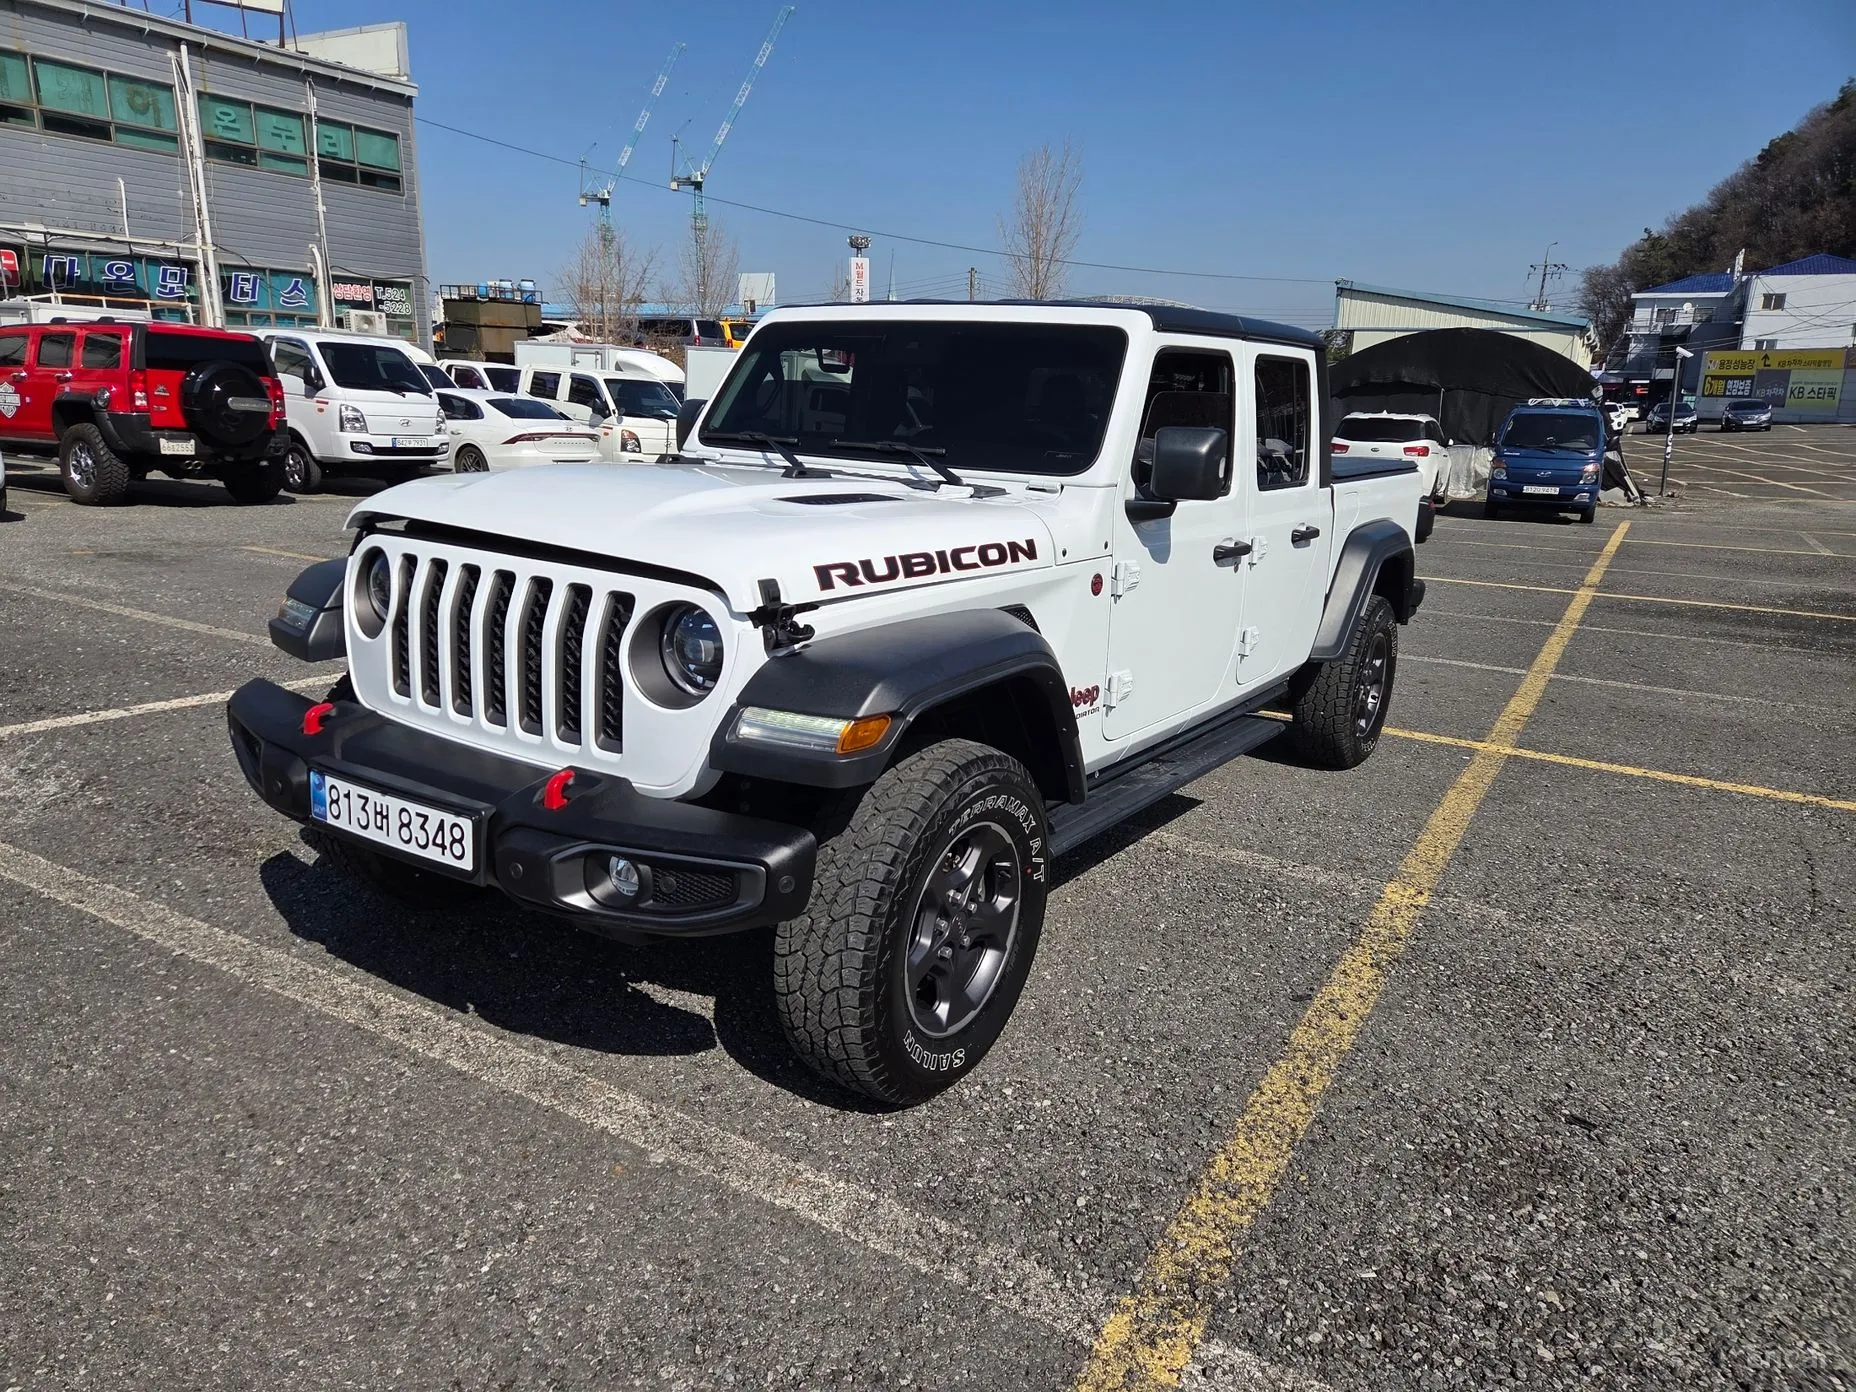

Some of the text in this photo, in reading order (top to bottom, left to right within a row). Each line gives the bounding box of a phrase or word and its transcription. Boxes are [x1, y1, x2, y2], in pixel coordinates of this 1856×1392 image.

[42, 254, 310, 308] 다온모터스
[333, 283, 372, 302] 상담환영
[1726, 380, 1752, 396] 연장보증
[1789, 386, 1837, 400] KB 스타픽
[812, 537, 1039, 592] RUBICON
[328, 783, 466, 861] 813버 8348
[948, 794, 1045, 882] TERRAMAX A/T
[903, 1029, 966, 1072] SAILUN
